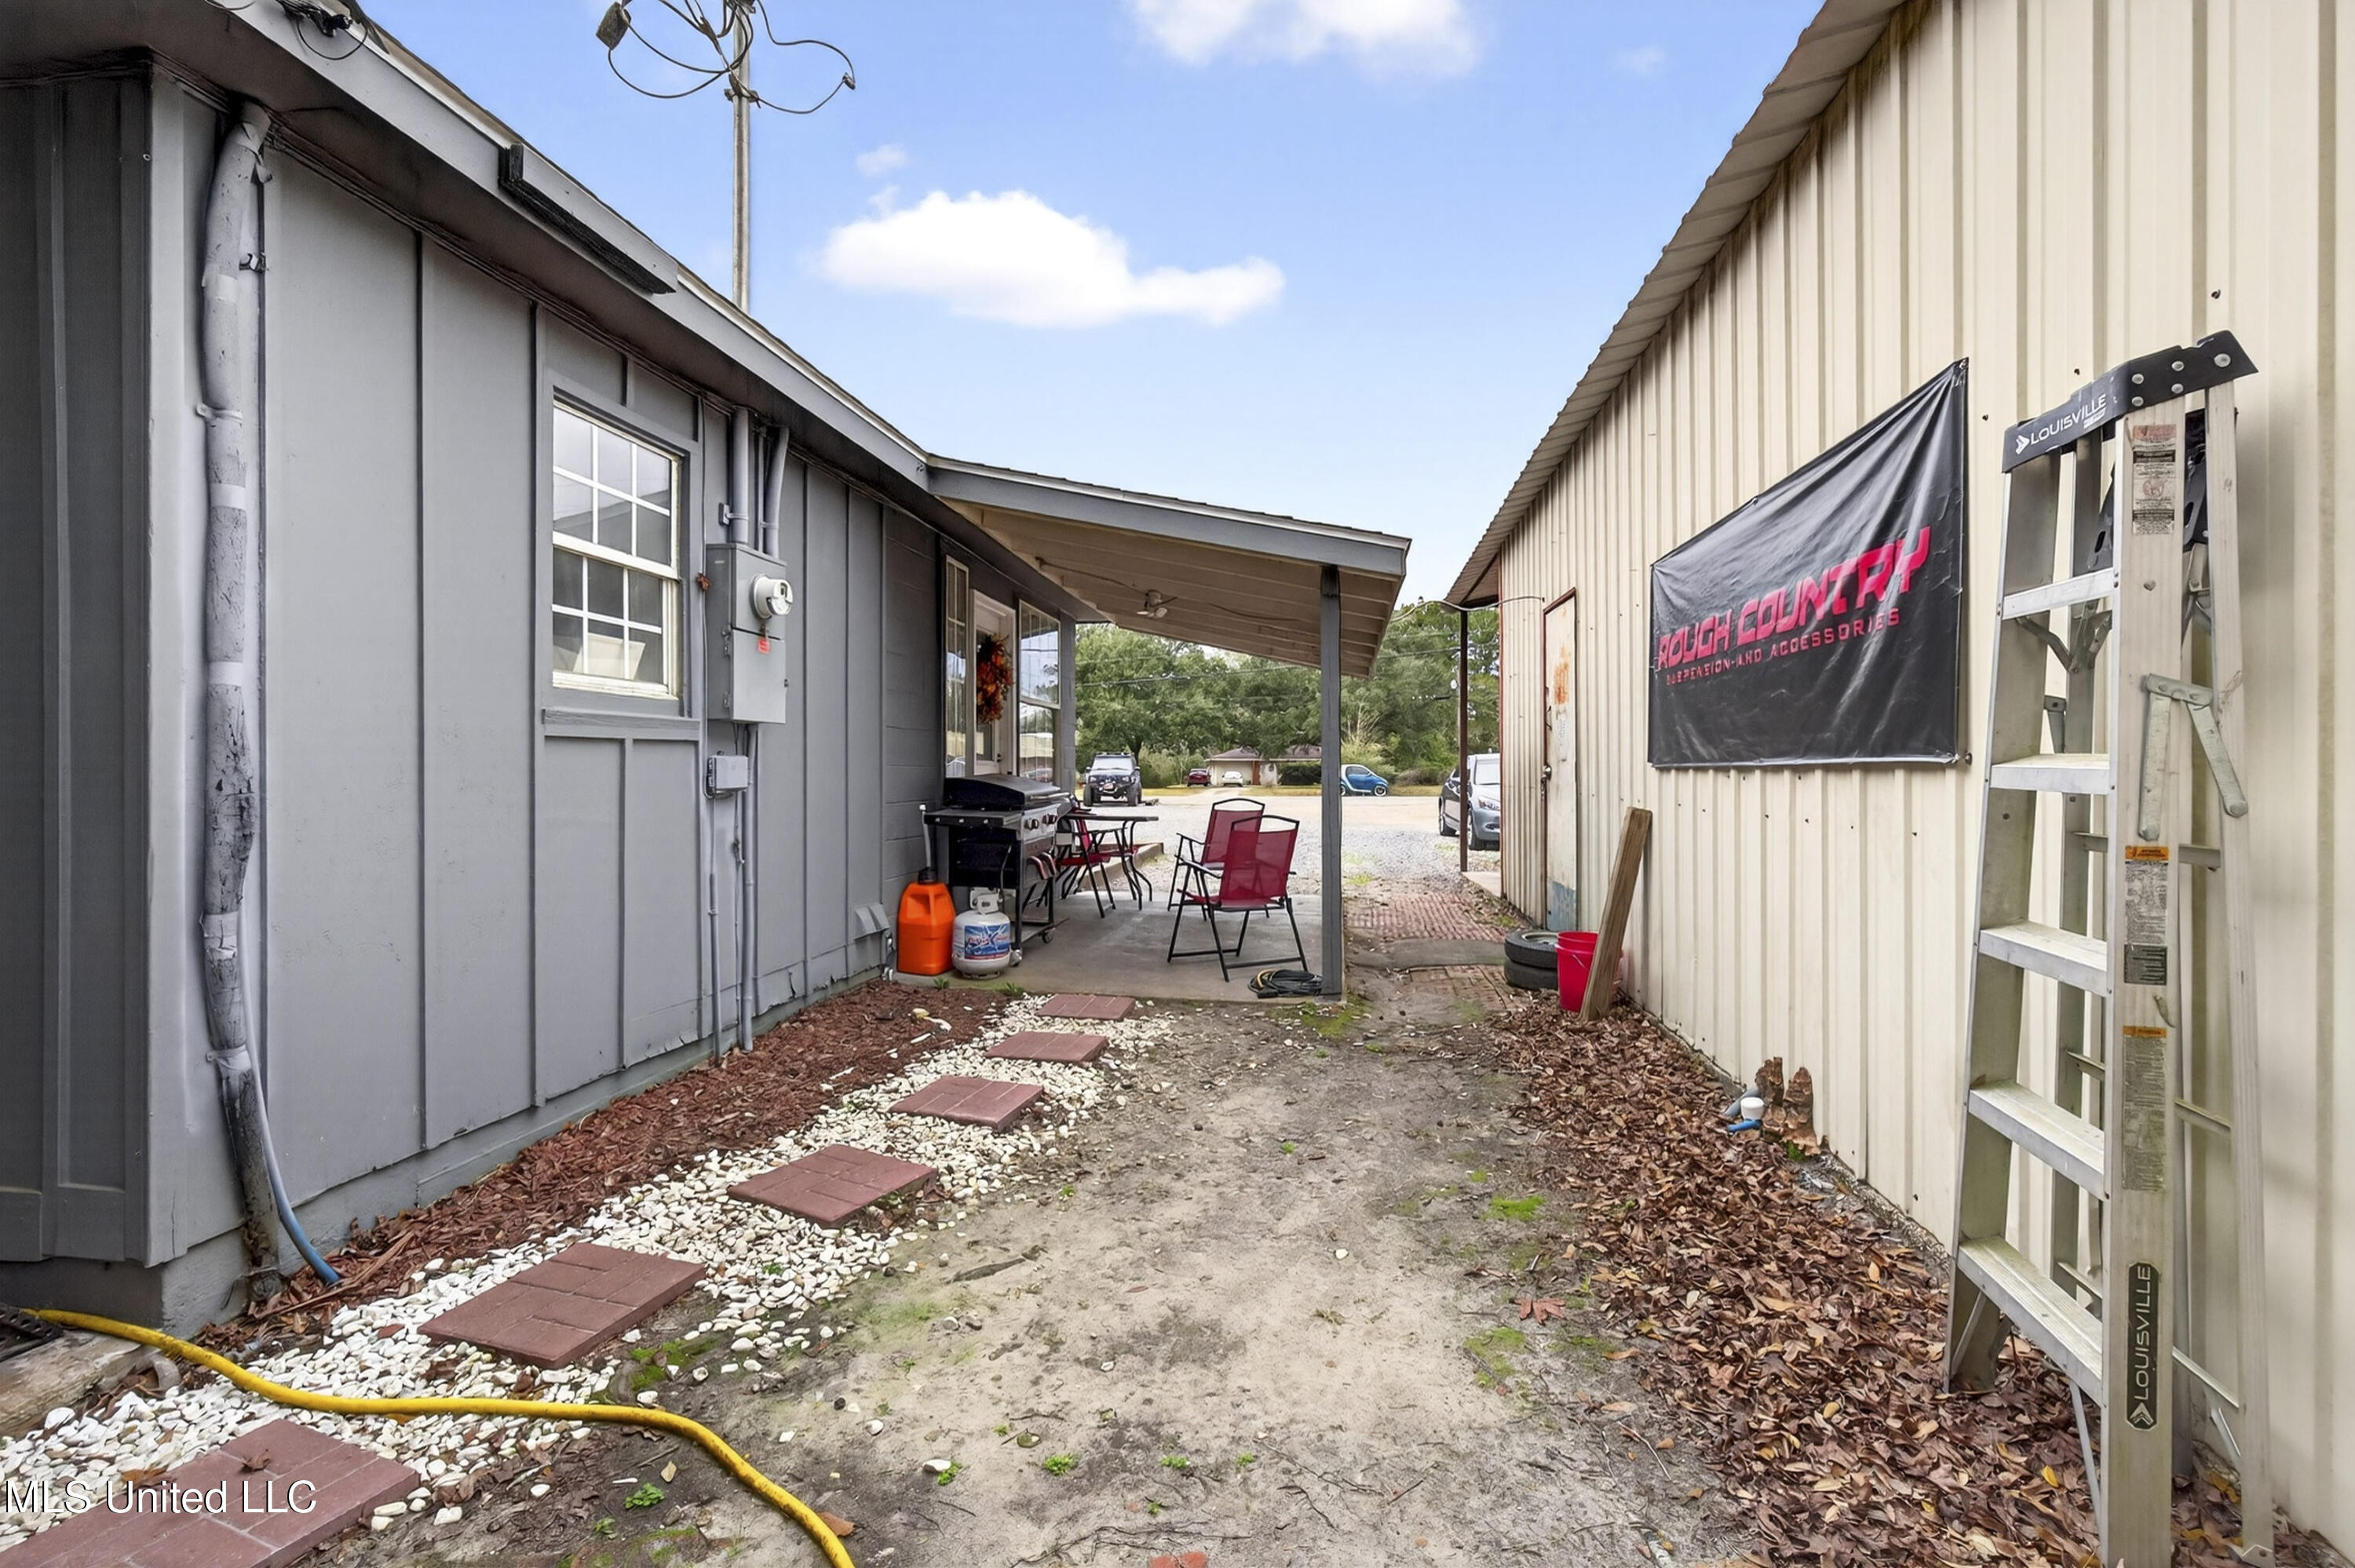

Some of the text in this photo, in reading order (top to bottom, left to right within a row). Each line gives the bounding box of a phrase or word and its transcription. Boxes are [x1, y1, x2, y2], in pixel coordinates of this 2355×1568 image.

[2030, 393, 2107, 445] LOUISVILLE
[1657, 526, 1931, 672] ROUGH COUNTRY
[1769, 607, 1900, 658] ACCESSORIES
[2134, 1265, 2152, 1401] LOUISVILLE
